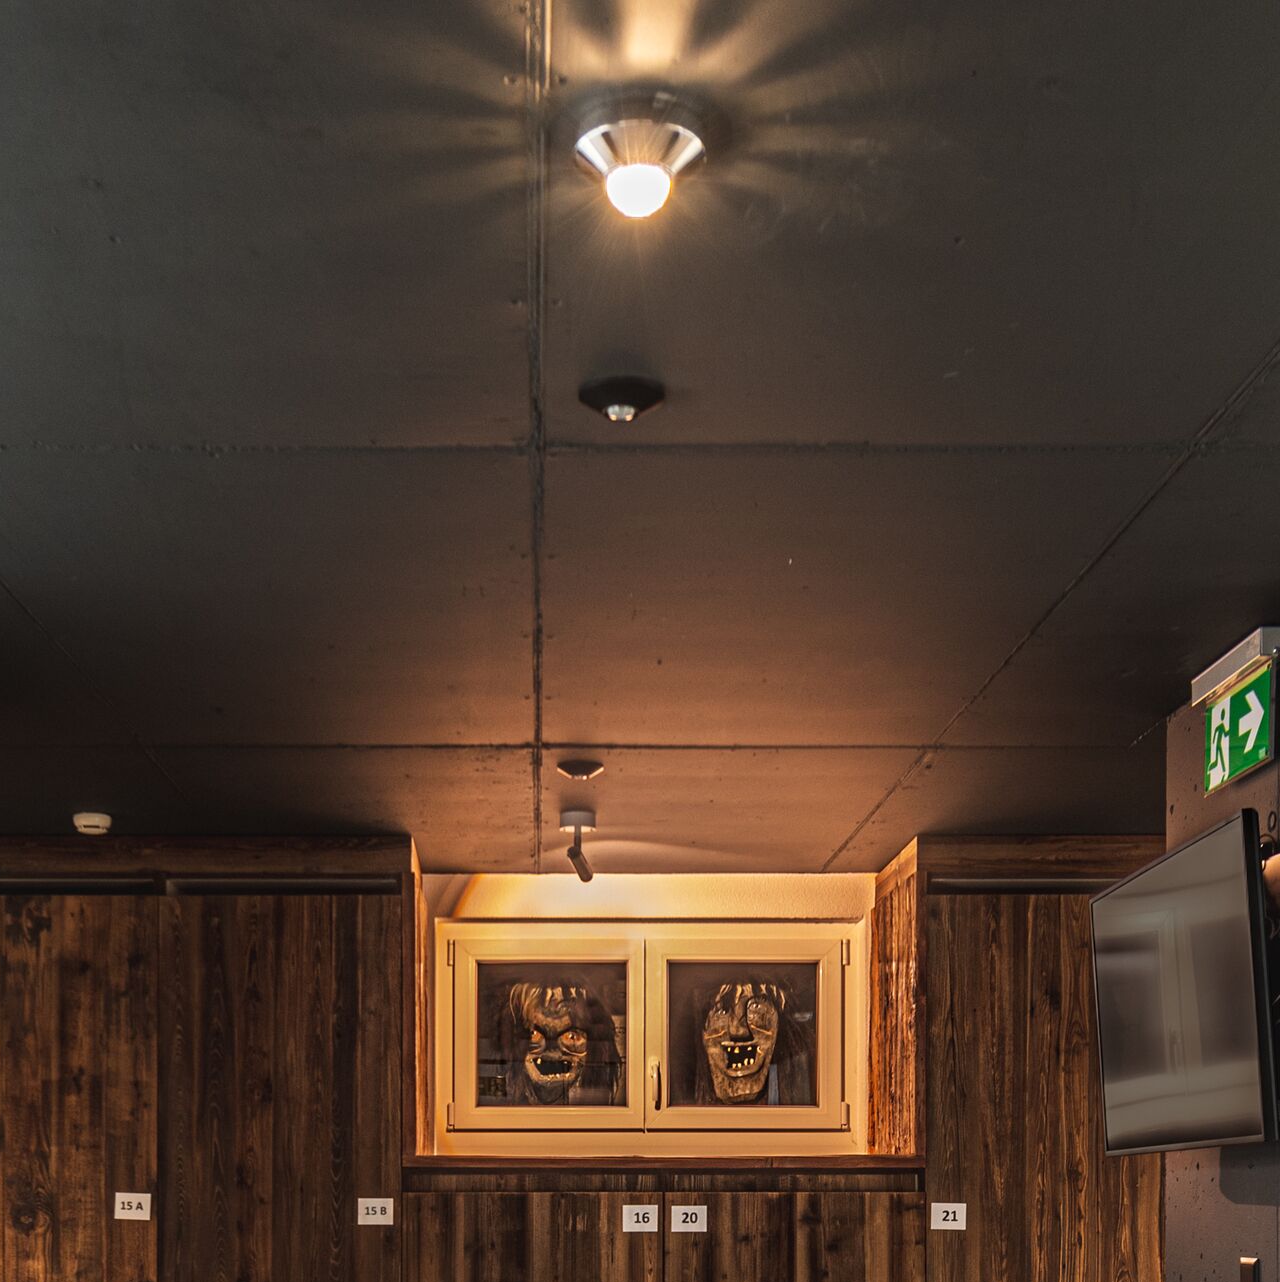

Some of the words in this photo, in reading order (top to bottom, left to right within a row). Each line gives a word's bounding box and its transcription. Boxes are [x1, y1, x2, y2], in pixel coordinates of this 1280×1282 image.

[120, 1201, 133, 1211] 15
[135, 1201, 144, 1212] A
[364, 1206, 377, 1216] 15
[380, 1206, 388, 1216] B
[633, 1212, 650, 1224] 16
[681, 1212, 698, 1224] 20
[941, 1210, 959, 1222] 21
